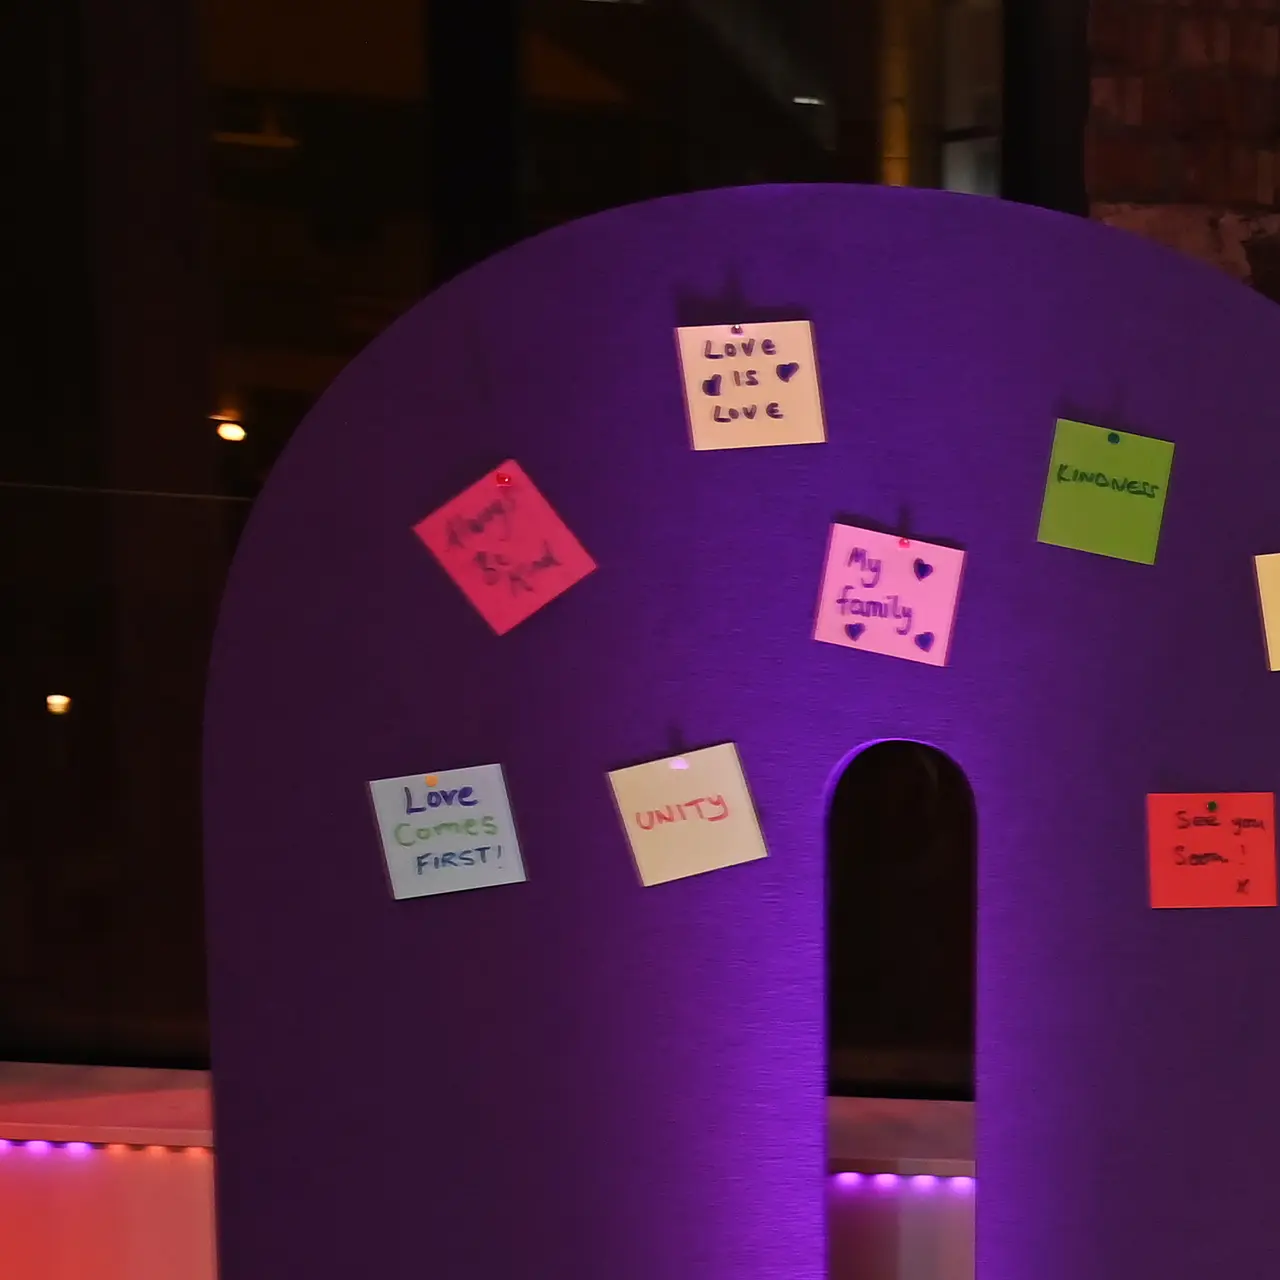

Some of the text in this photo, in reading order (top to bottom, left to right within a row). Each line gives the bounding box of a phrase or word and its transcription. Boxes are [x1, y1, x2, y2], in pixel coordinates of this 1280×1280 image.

[1055, 462, 1160, 500] KINDNESS
[847, 546, 882, 588] My
[403, 783, 479, 815] Love
[635, 793, 731, 832] UNITY
